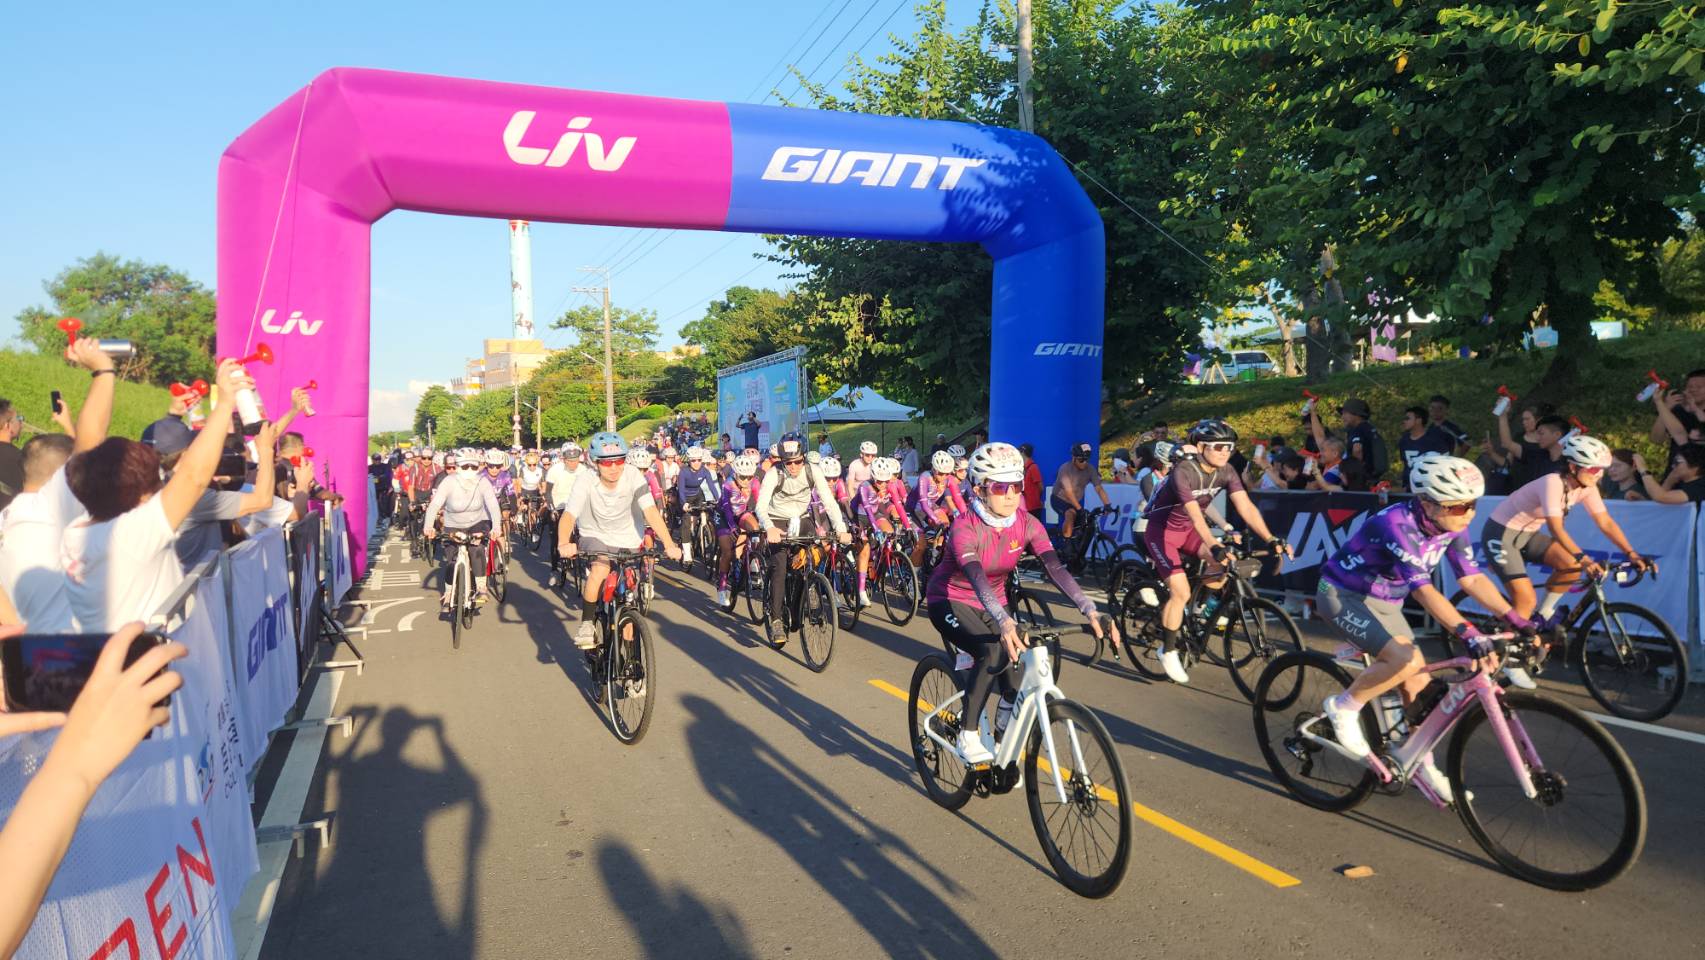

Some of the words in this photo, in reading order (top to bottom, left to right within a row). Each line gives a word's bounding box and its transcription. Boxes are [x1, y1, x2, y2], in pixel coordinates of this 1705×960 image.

[503, 110, 637, 172] Liv
[761, 146, 988, 190] GIANT
[261, 308, 324, 335] Liv
[1033, 342, 1102, 357] GIANT
